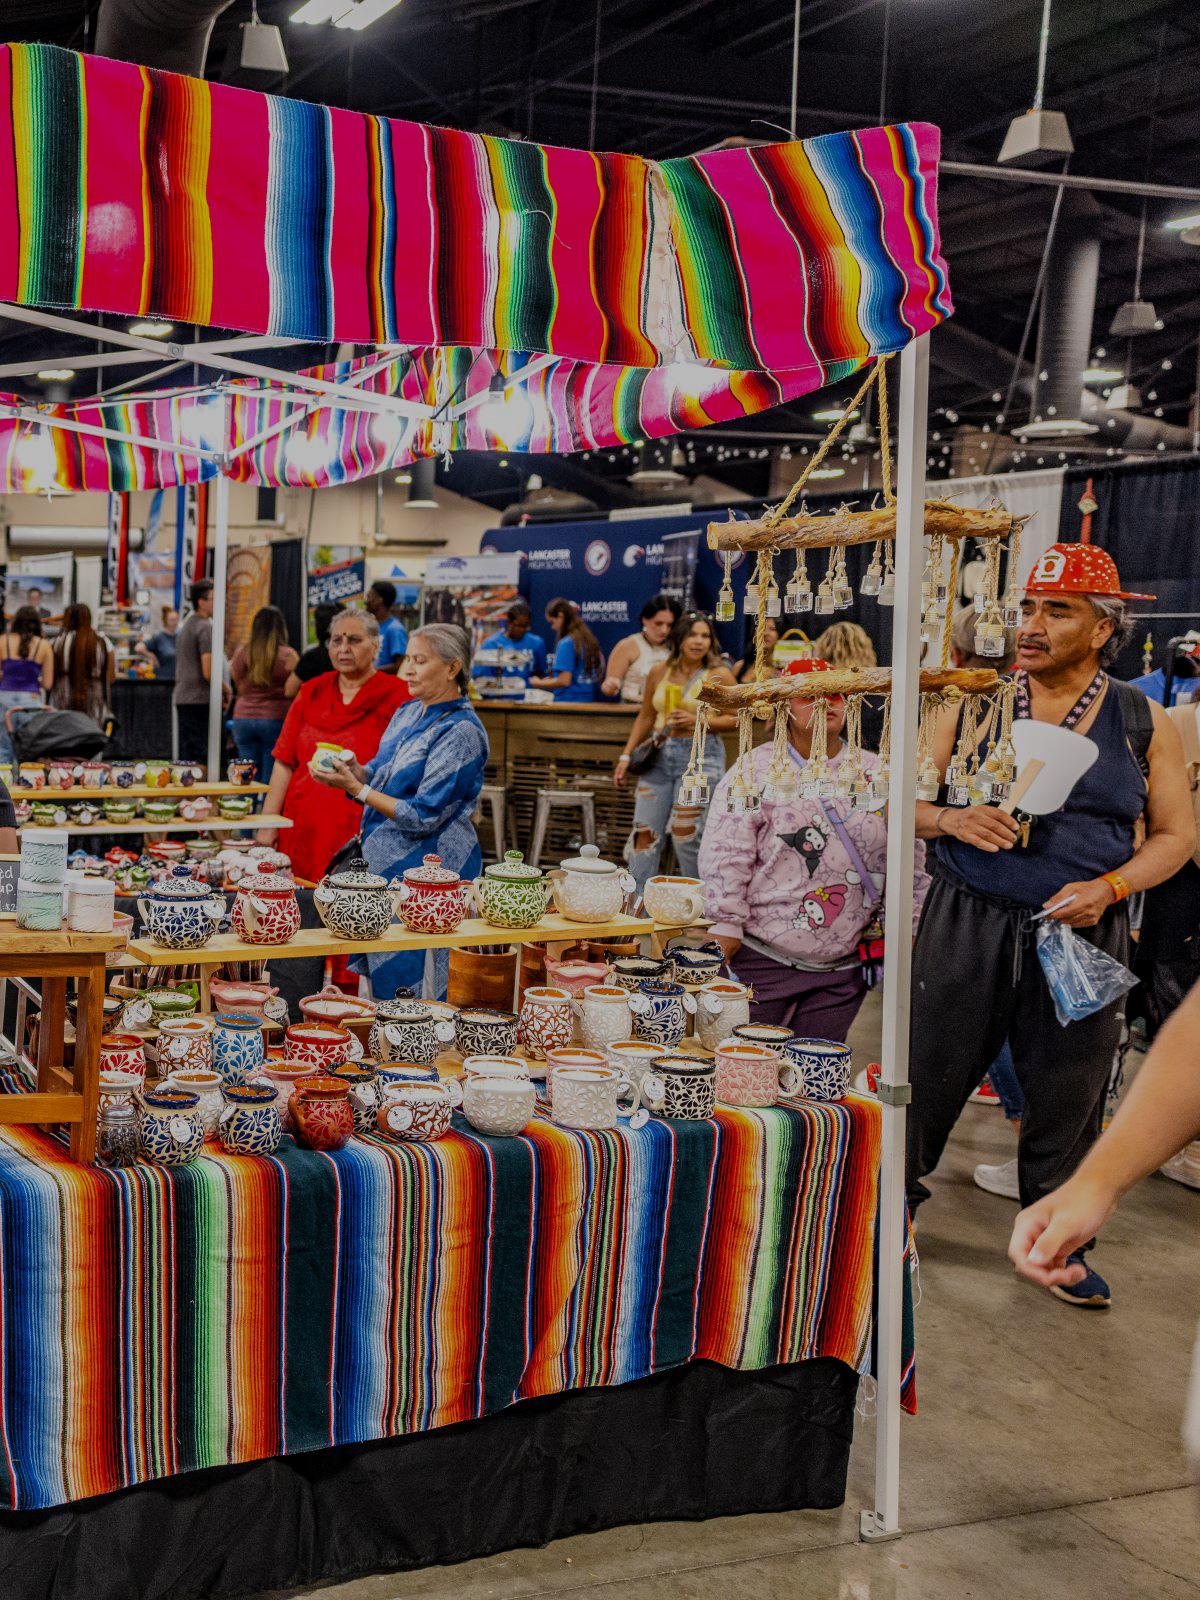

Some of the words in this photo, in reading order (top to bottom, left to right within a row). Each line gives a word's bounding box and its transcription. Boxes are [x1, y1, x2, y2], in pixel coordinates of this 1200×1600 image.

[528, 549, 571, 561] LANCASTER
[528, 561, 545, 570] HIGH
[545, 560, 572, 570] SCHOOL
[582, 600, 628, 612] LANCASTER
[582, 611, 599, 622] HIGH
[599, 611, 630, 622] SCHOOL
